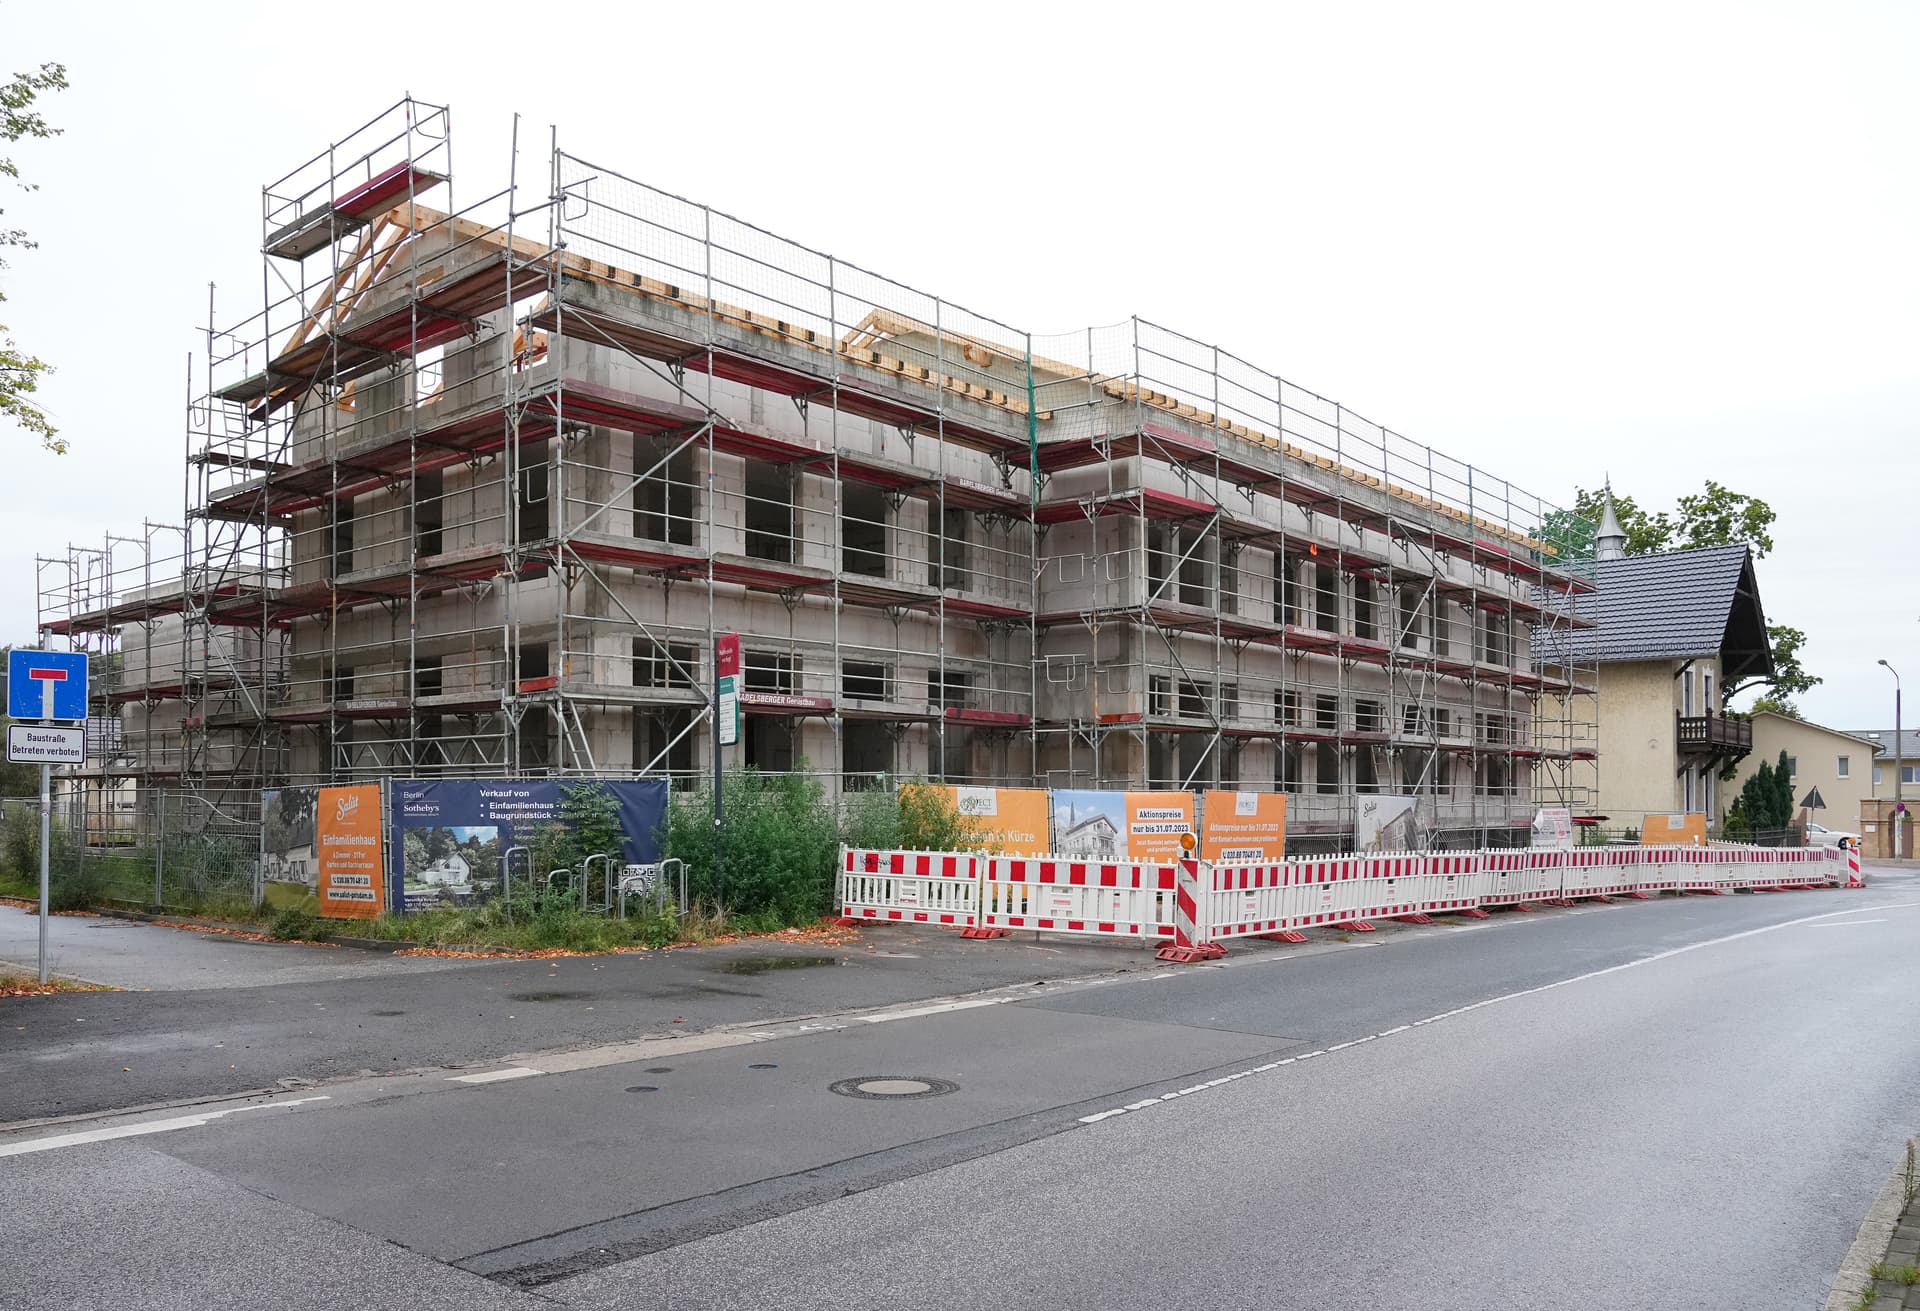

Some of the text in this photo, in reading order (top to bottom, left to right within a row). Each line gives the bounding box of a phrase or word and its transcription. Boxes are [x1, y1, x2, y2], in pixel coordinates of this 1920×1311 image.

[786, 697, 816, 706] Gerüstbau
[27, 733, 66, 743] Baustraße
[12, 744, 80, 756] Betreten verboten
[403, 791, 425, 799] Berlin
[403, 803, 440, 813] Sotheby's
[490, 811, 552, 820] Baugrundstück
[1139, 810, 1181, 819] Aktionspreise
[1156, 824, 1189, 832] 31.07.2023
[323, 834, 376, 846] Einfamilienhaus
[1007, 830, 1035, 842] Kürze
